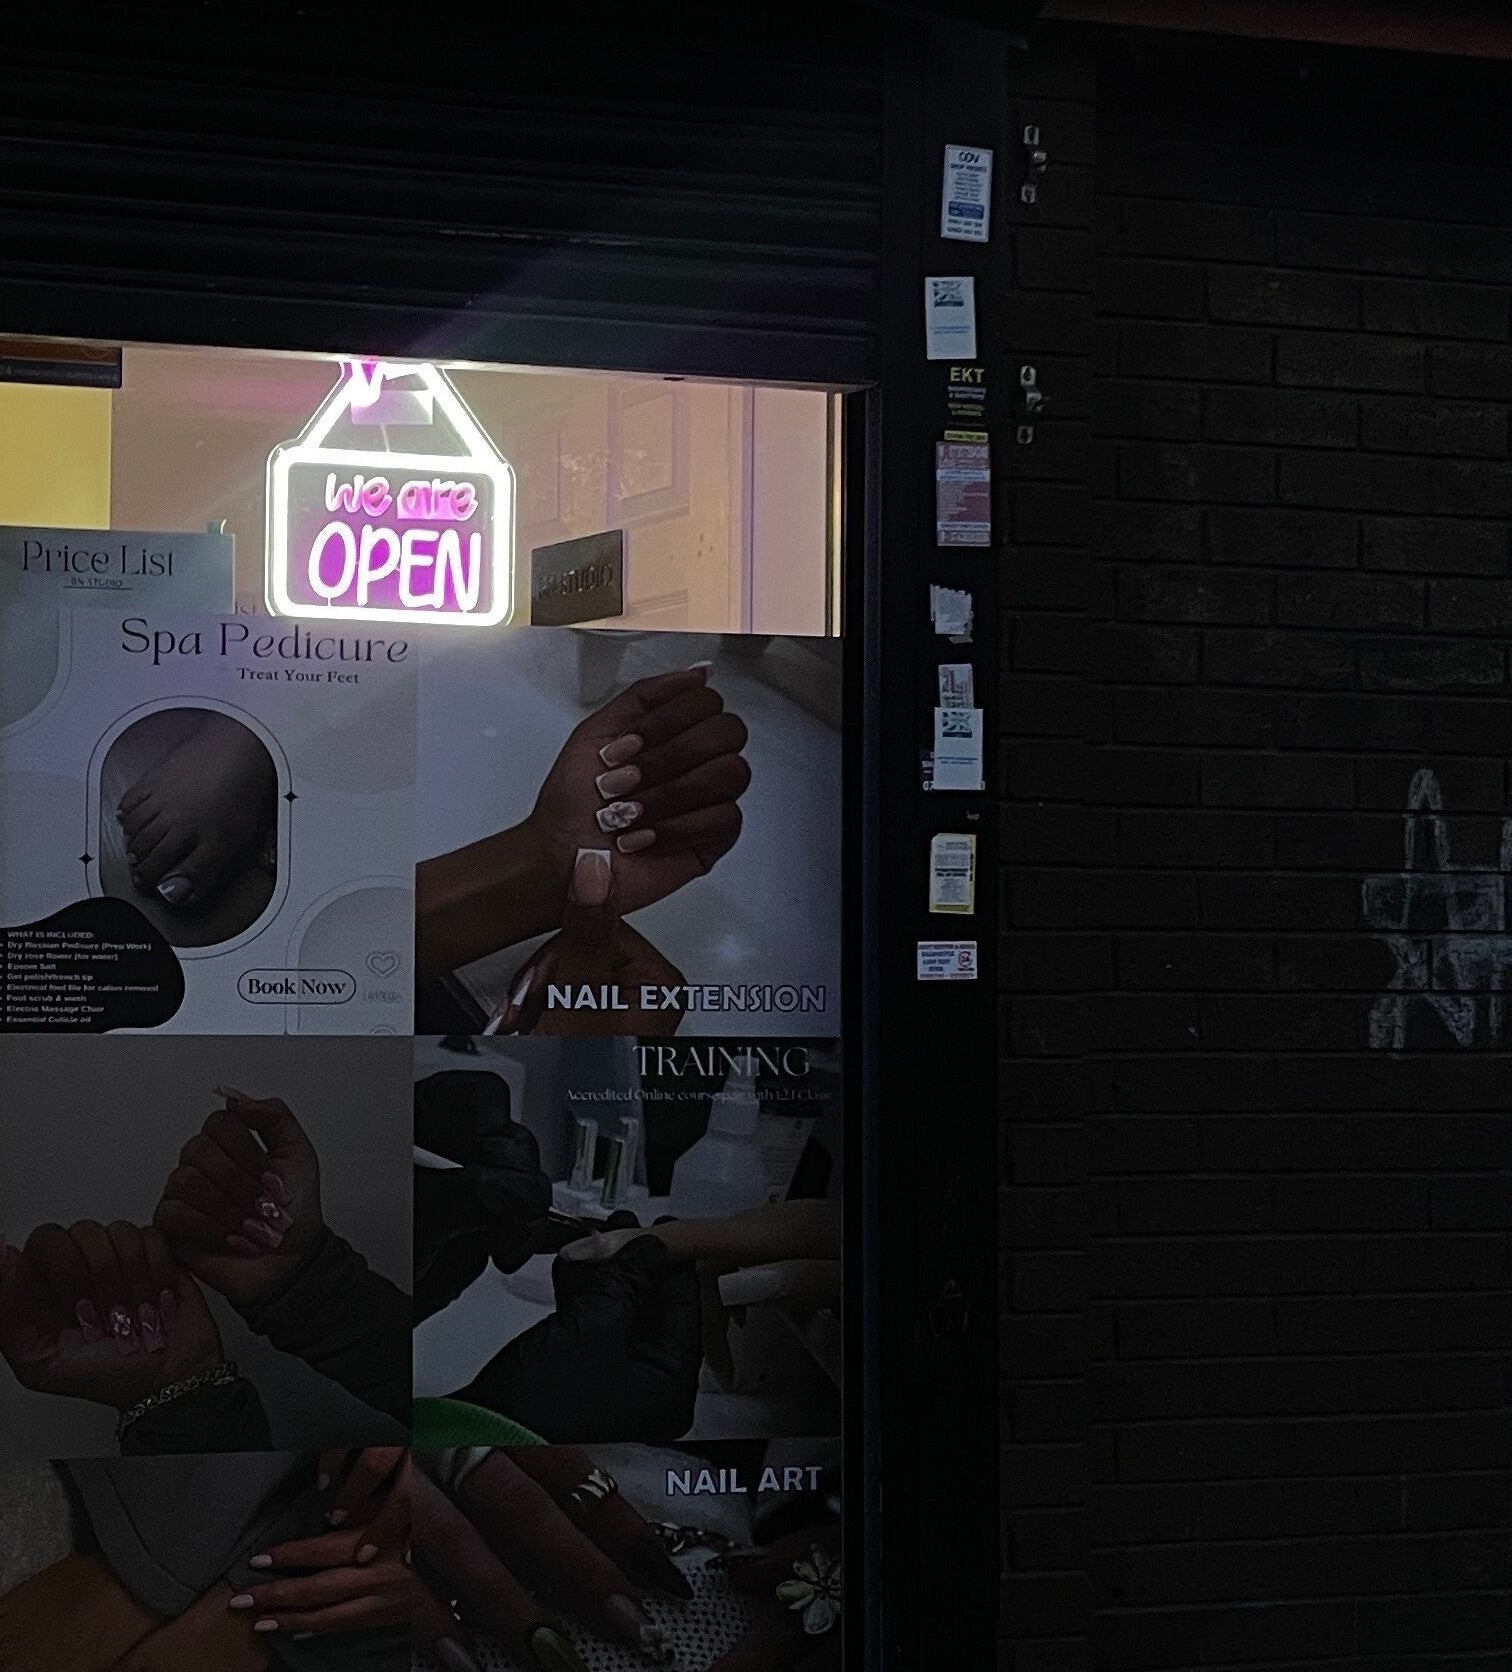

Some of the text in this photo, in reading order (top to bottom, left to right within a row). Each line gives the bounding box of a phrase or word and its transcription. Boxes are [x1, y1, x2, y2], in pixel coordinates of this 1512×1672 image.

[949, 366, 985, 384] EKT
[23, 540, 174, 577] Price List
[308, 521, 482, 611] OPEN
[121, 618, 409, 666] Spa Pedicure
[237, 667, 360, 684] Treat Your Feet
[7, 941, 23, 950] Dry
[7, 952, 22, 960] Dry
[248, 978, 346, 995] Book Now
[547, 984, 827, 1014] NAIL EXTENSION
[41, 1005, 79, 1014] Massage
[632, 1046, 810, 1077] TRAINING
[567, 1088, 632, 1101] Accredited
[634, 1088, 674, 1101] Online
[667, 1466, 823, 1495] NAIL ART
